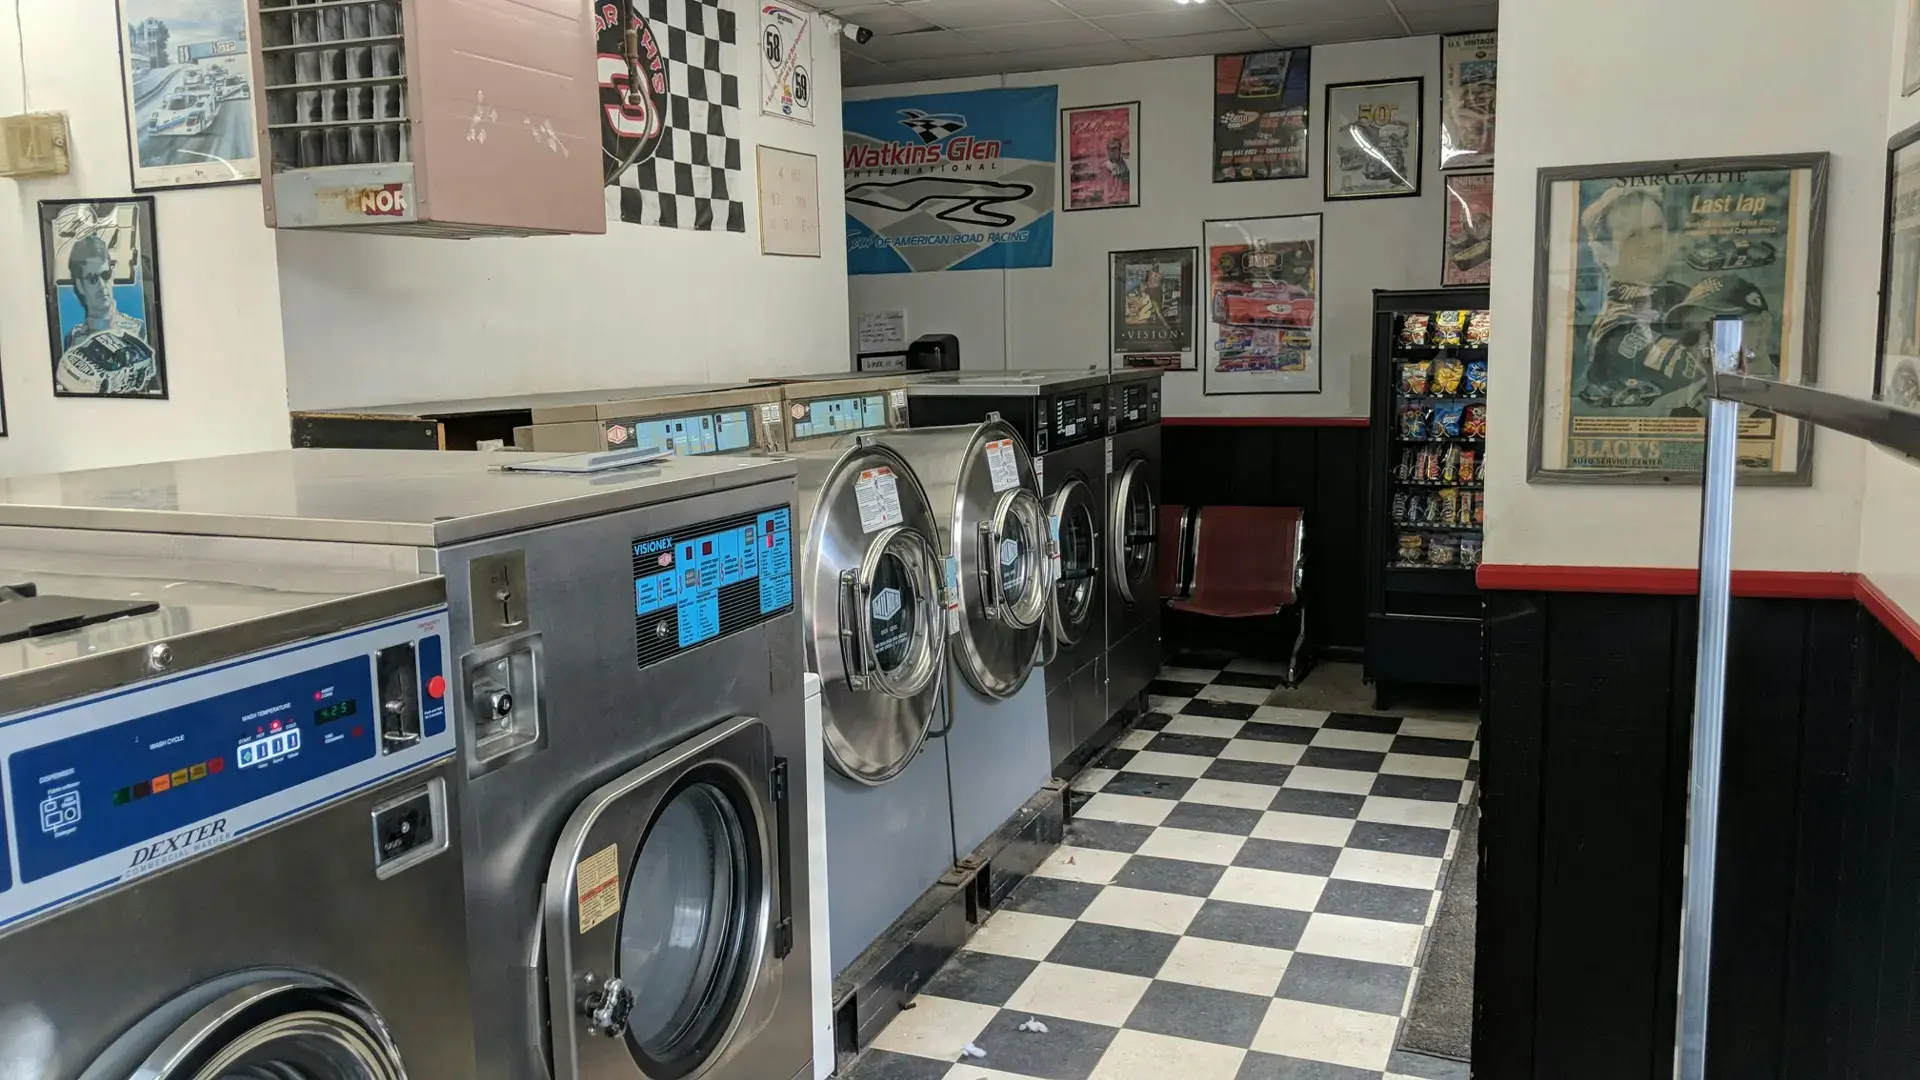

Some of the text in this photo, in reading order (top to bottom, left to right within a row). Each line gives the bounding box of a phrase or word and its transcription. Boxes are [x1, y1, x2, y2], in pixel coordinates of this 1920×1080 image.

[766, 31, 780, 62] 58
[1464, 37, 1494, 47] VINTAGE
[795, 72, 807, 101] 59
[844, 136, 1001, 168] Watkins Glen
[845, 163, 996, 179] INTERNATIONAL
[1691, 194, 1766, 215] Last lap
[875, 238, 892, 247] OF
[893, 235, 950, 247] AMERICAN
[952, 233, 983, 245] ROAD
[987, 231, 1029, 243] RACING
[1127, 330, 1178, 339] VISION
[1572, 439, 1660, 458] BLACK'S
[1572, 458, 1593, 466] AUTO
[1632, 458, 1662, 466] CENTER
[634, 537, 673, 556] VISIONEX
[242, 702, 291, 722] WASH TEMPERATURE
[149, 734, 185, 750] WASH CYCLE
[238, 736, 252, 744] START
[129, 818, 227, 868] DEXTER
[125, 832, 232, 878] COMMERCIAL WASHER
